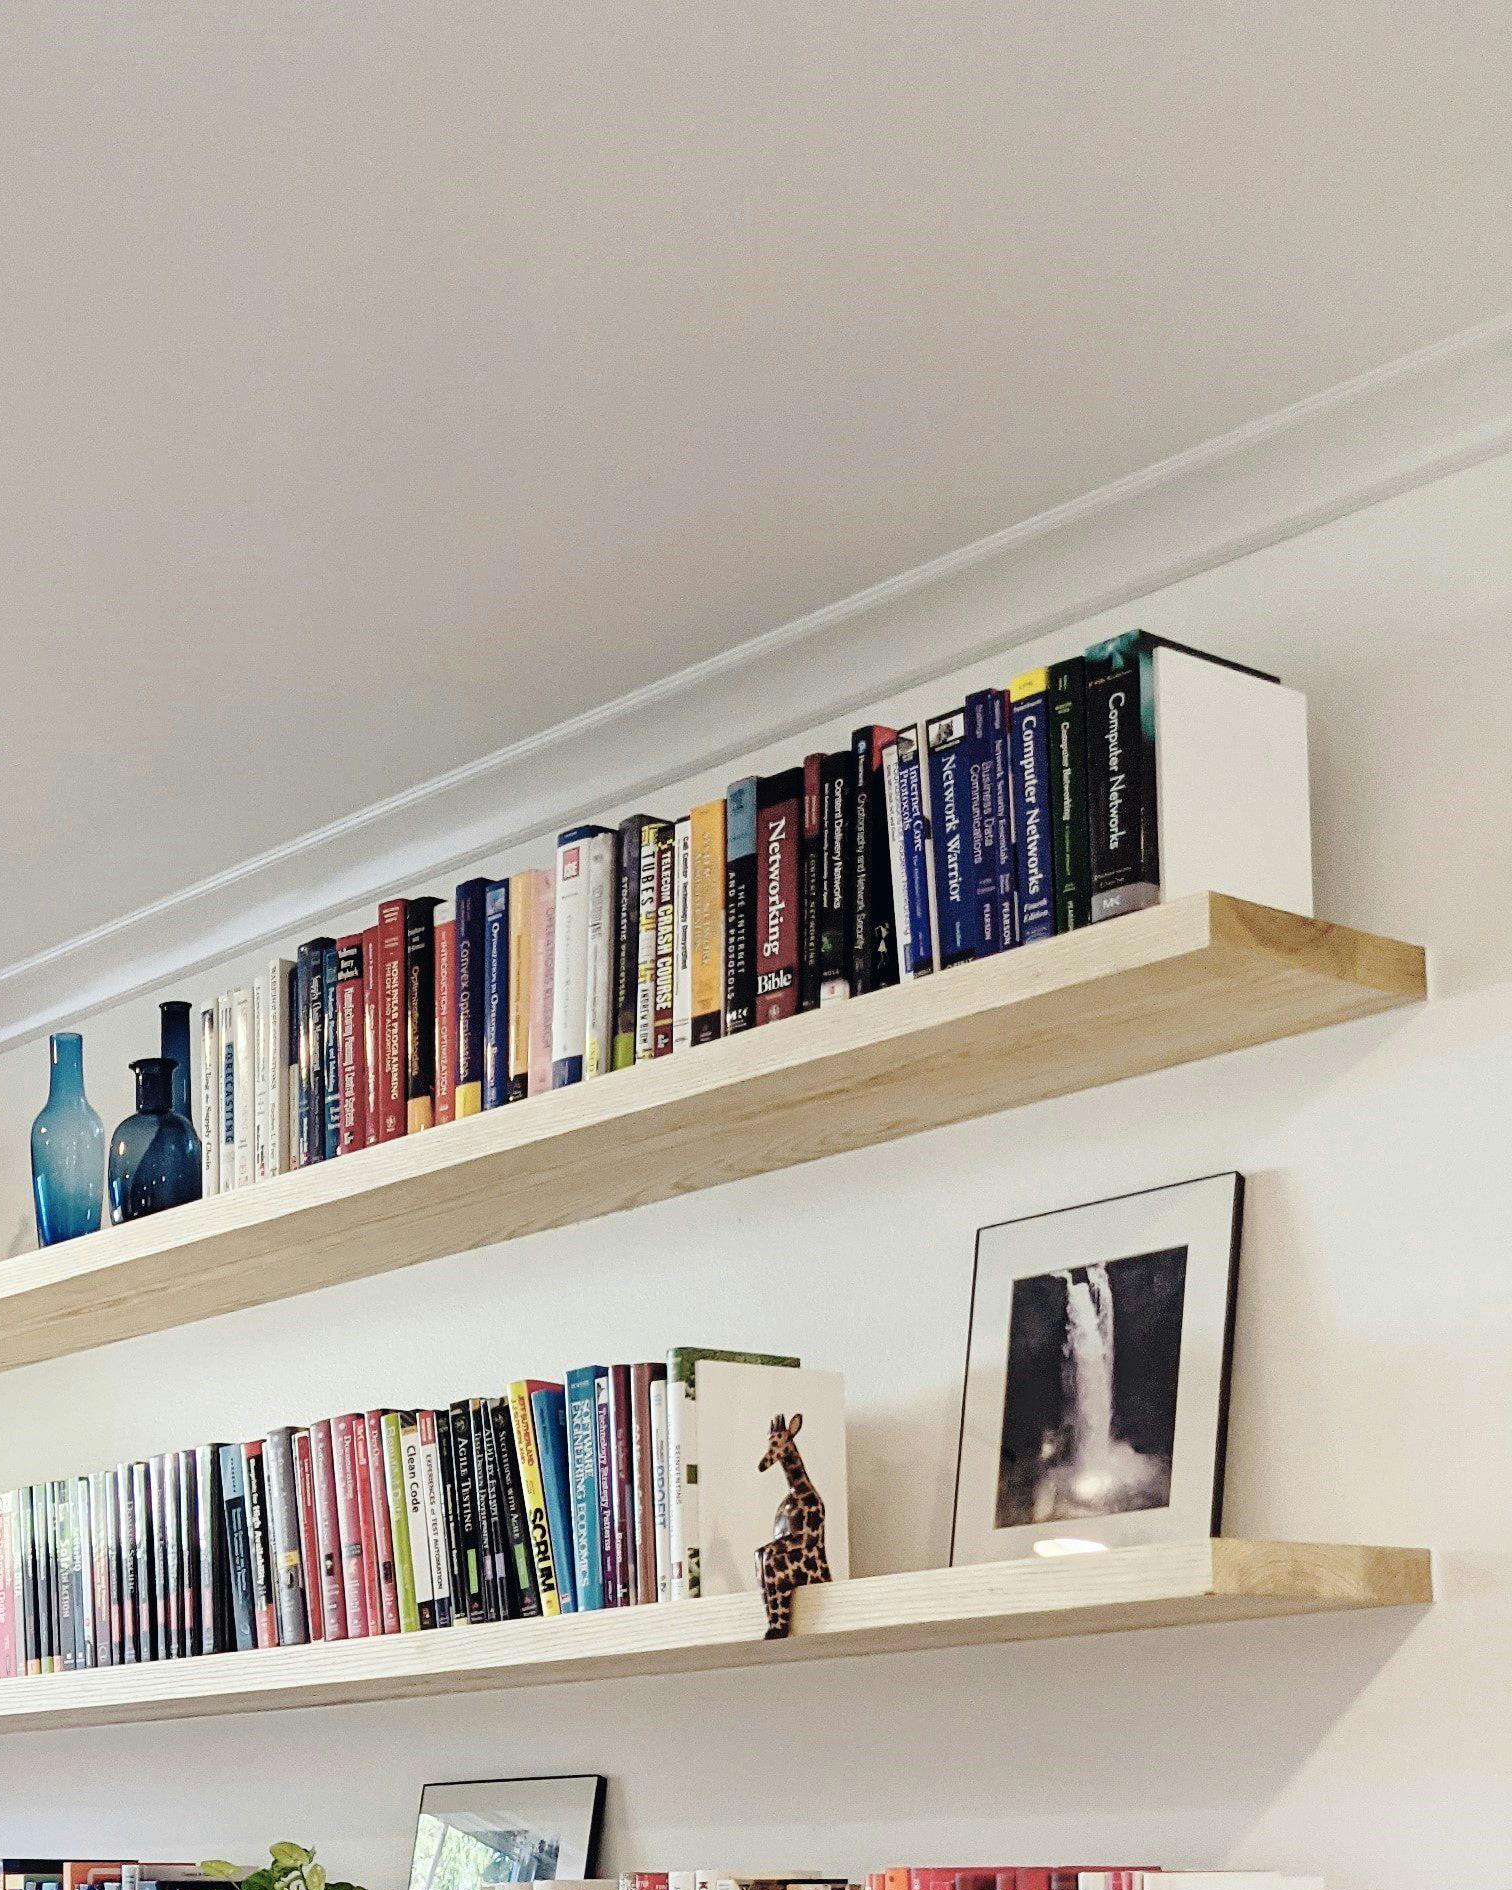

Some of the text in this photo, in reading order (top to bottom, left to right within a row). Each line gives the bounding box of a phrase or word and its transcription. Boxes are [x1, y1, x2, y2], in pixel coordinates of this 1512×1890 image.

[899, 769, 912, 831] Protocols
[909, 765, 921, 816] Internet
[970, 764, 984, 864] Communications
[982, 761, 995, 847] Business Data
[1020, 715, 1043, 895] Computer Networks
[1105, 692, 1126, 850] Computer Networks
[832, 779, 843, 909] Content Delivery Networks
[913, 819, 924, 852] Core
[941, 755, 962, 902] Network Warrior
[656, 851, 674, 1010] TELECOM CRASH COURSE
[737, 884, 745, 974] THE INTERNET
[763, 816, 786, 958] Networking
[1001, 902, 1011, 945] PEARSON
[727, 872, 736, 1000] AND ITS PROTOCOLS
[757, 969, 792, 995] Bible
[439, 941, 448, 1096] INTRODUCTION OPTIMIZATION
[460, 940, 471, 1081] Convex Optimization
[406, 1445, 422, 1514] Clean Code
[426, 1454, 437, 1505] EXPERIENCES
[457, 1436, 474, 1533] AGILE TESTING
[581, 1400, 595, 1479] SOFTWARE
[598, 1407, 613, 1551] Technology Strategy Patterns
[431, 1518, 440, 1536] TEST
[570, 1401, 591, 1588] ENGINEERING ECONOMICS
[432, 1539, 444, 1590] AUTOMATION
[529, 1507, 555, 1594] SCRUM
